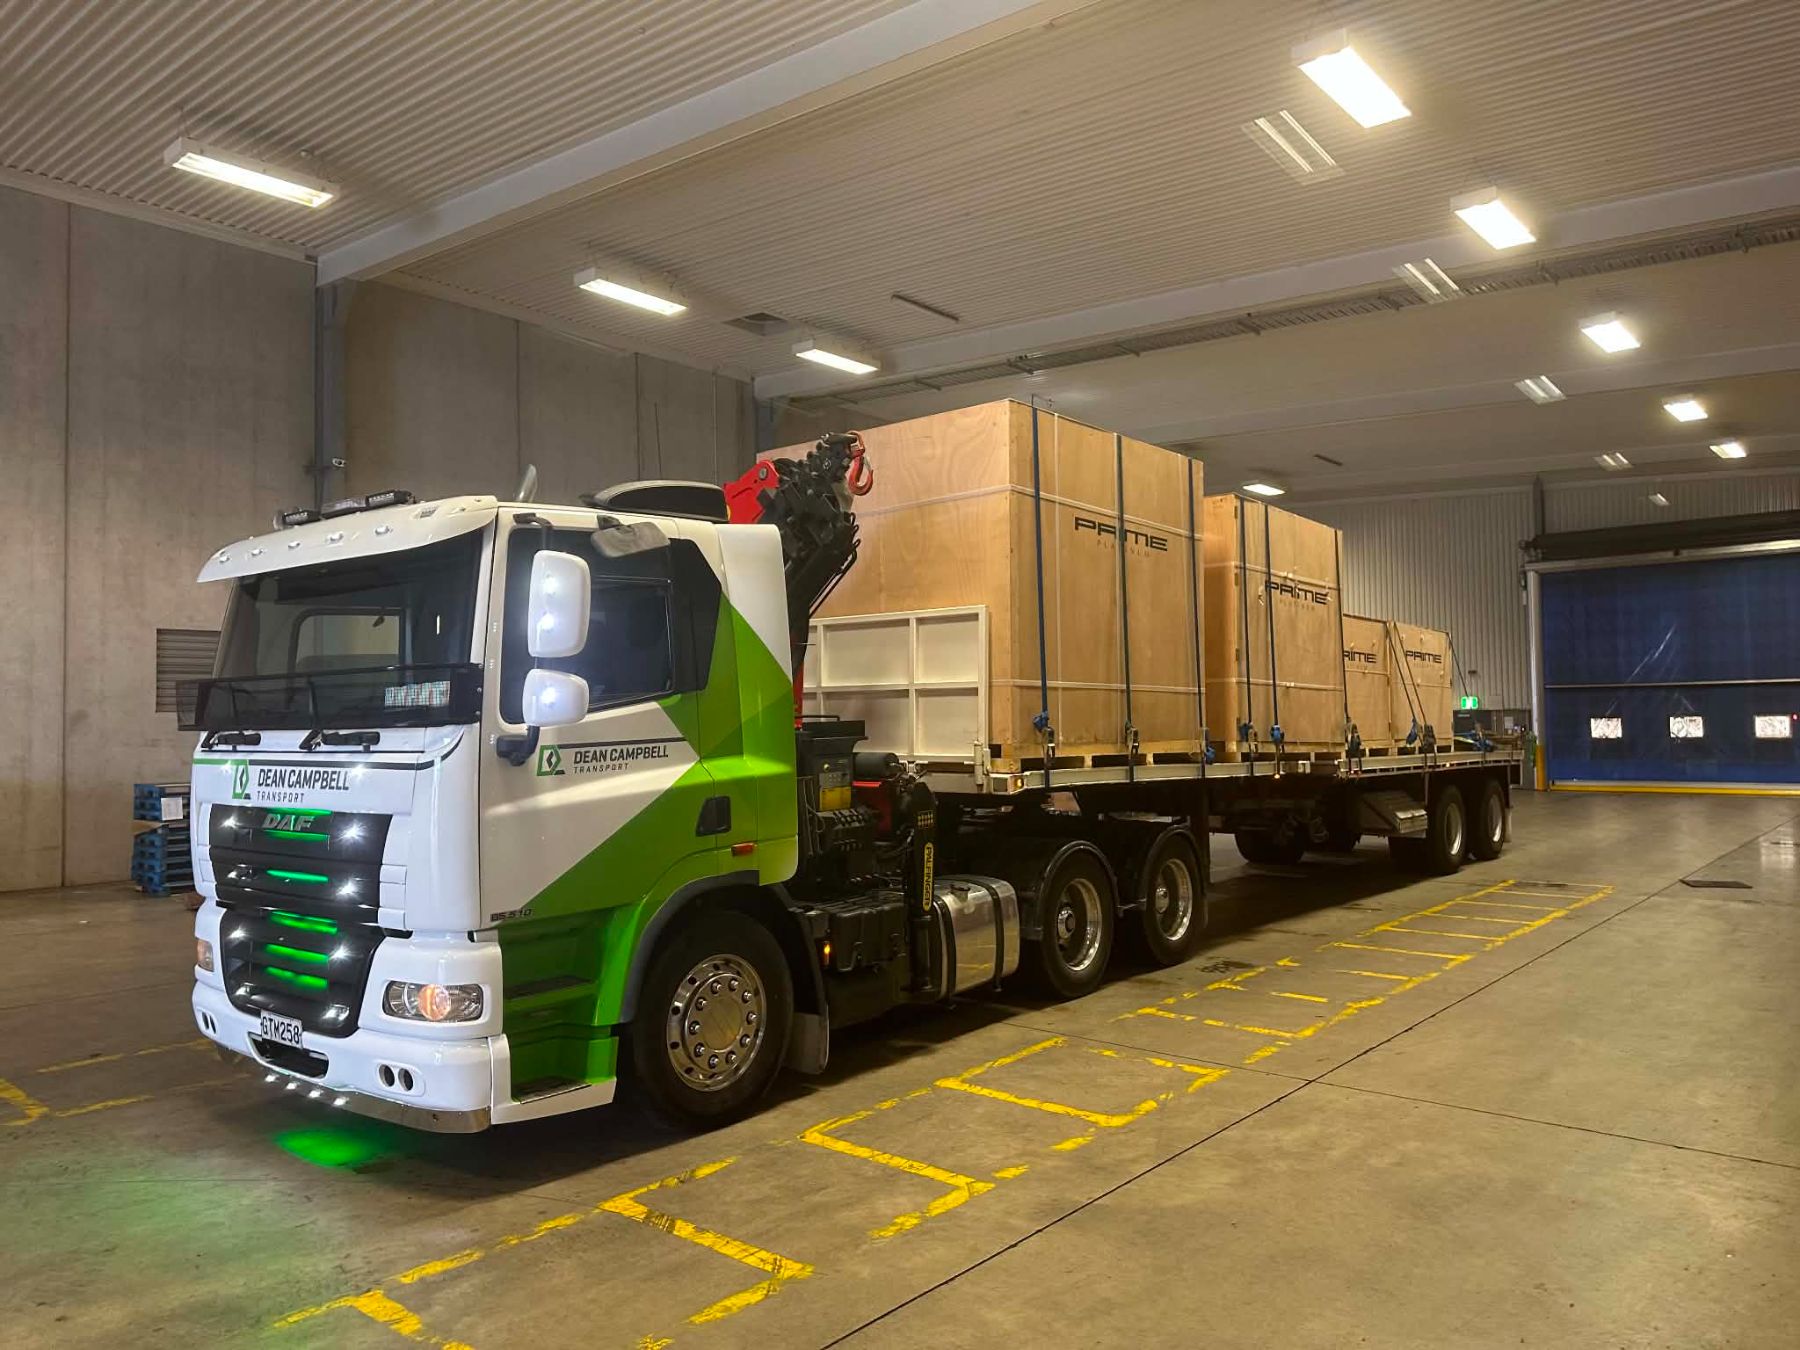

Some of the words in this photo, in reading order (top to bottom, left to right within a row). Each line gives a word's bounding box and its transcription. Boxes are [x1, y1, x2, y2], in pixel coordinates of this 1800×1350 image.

[1074, 516, 1168, 552] PRME
[1265, 579, 1330, 605] PRIME
[1343, 650, 1377, 664] RIME
[1405, 650, 1442, 664] PRIME
[574, 749, 608, 764] DEAN
[610, 745, 669, 761] CAMPBELL
[573, 763, 630, 774] TRANSPORT
[257, 768, 287, 788] DEAN
[288, 769, 349, 790] CAMPBELL
[256, 791, 305, 803] TRANSPORT
[262, 813, 315, 831] DAF
[262, 1016, 300, 1044] GTM258
